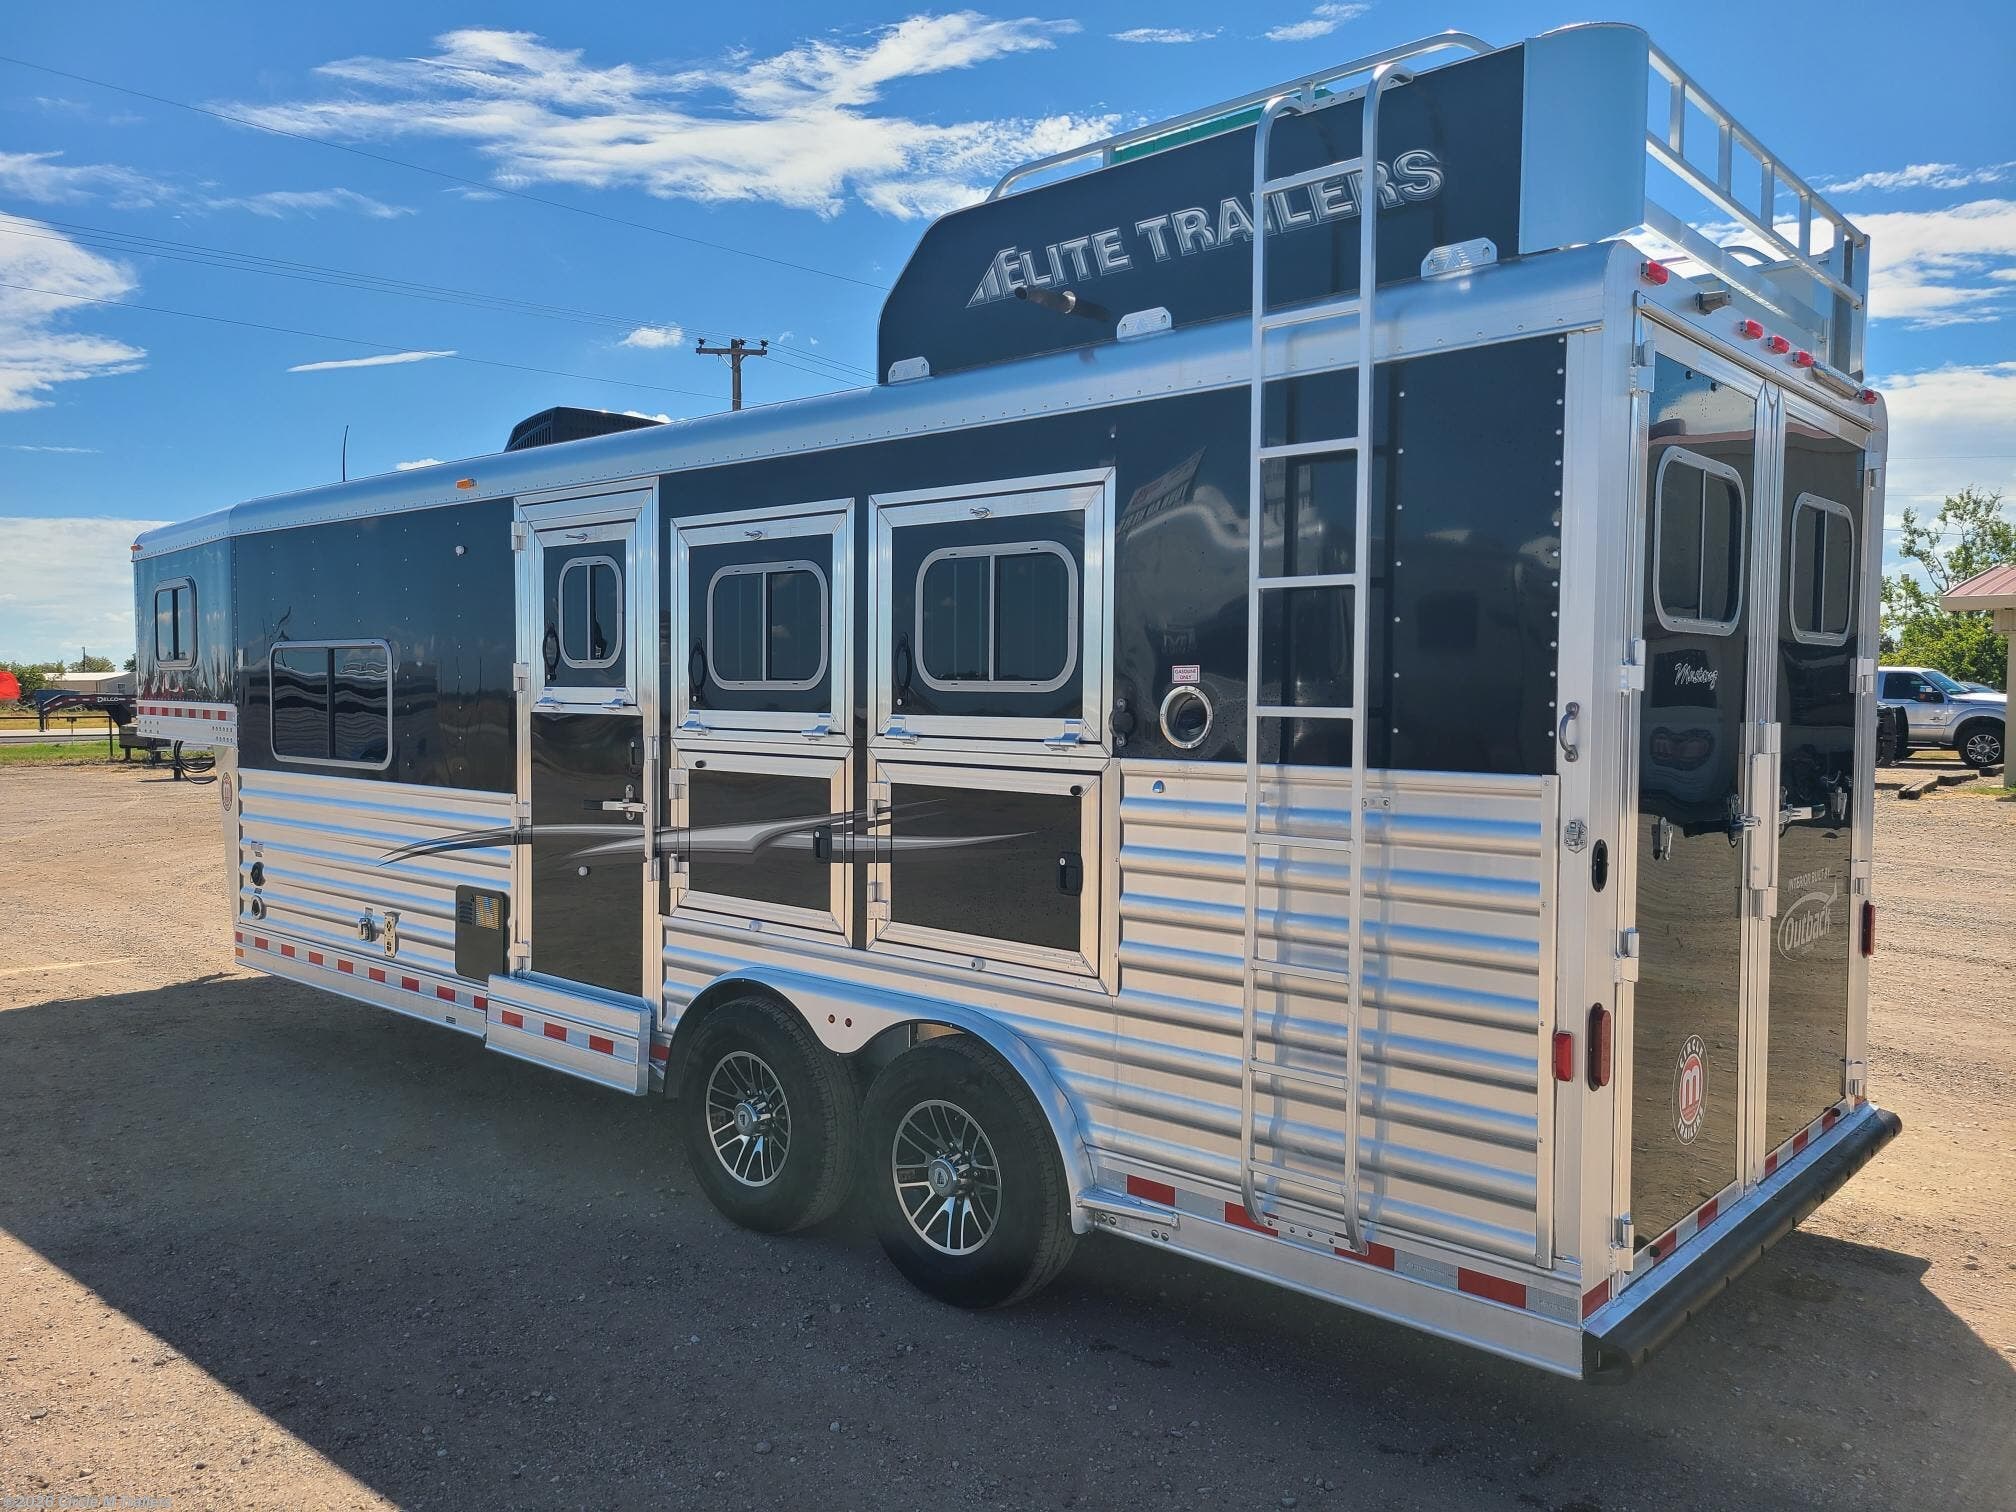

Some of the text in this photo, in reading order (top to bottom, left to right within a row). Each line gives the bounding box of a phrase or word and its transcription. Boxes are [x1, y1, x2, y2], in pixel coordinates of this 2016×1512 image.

[967, 227, 1135, 308] ELITE
[1784, 906, 1832, 951] Outback
[1680, 1039, 1703, 1068] CIRCLE
[1678, 1105, 1704, 1139] TRAILERS
